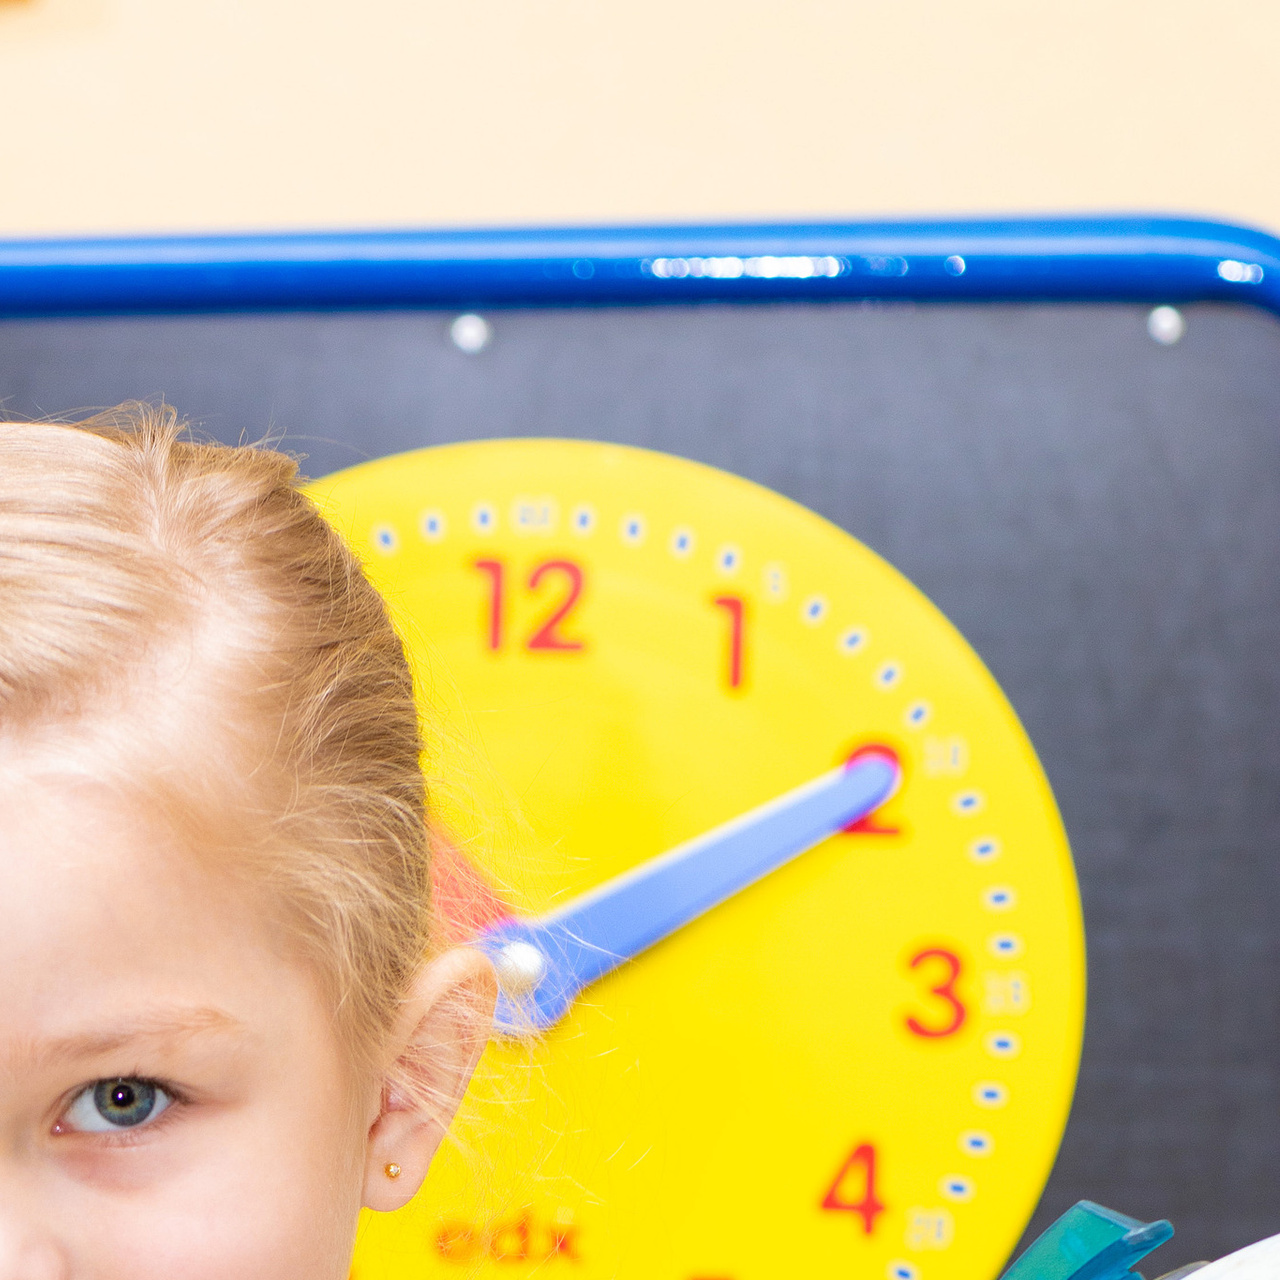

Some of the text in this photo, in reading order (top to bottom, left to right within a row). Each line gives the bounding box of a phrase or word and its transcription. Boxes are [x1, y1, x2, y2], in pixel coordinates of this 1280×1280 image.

[474, 558, 586, 652] 12
[713, 593, 746, 688] 1
[902, 949, 967, 1039] 3
[821, 1143, 888, 1236] 4
